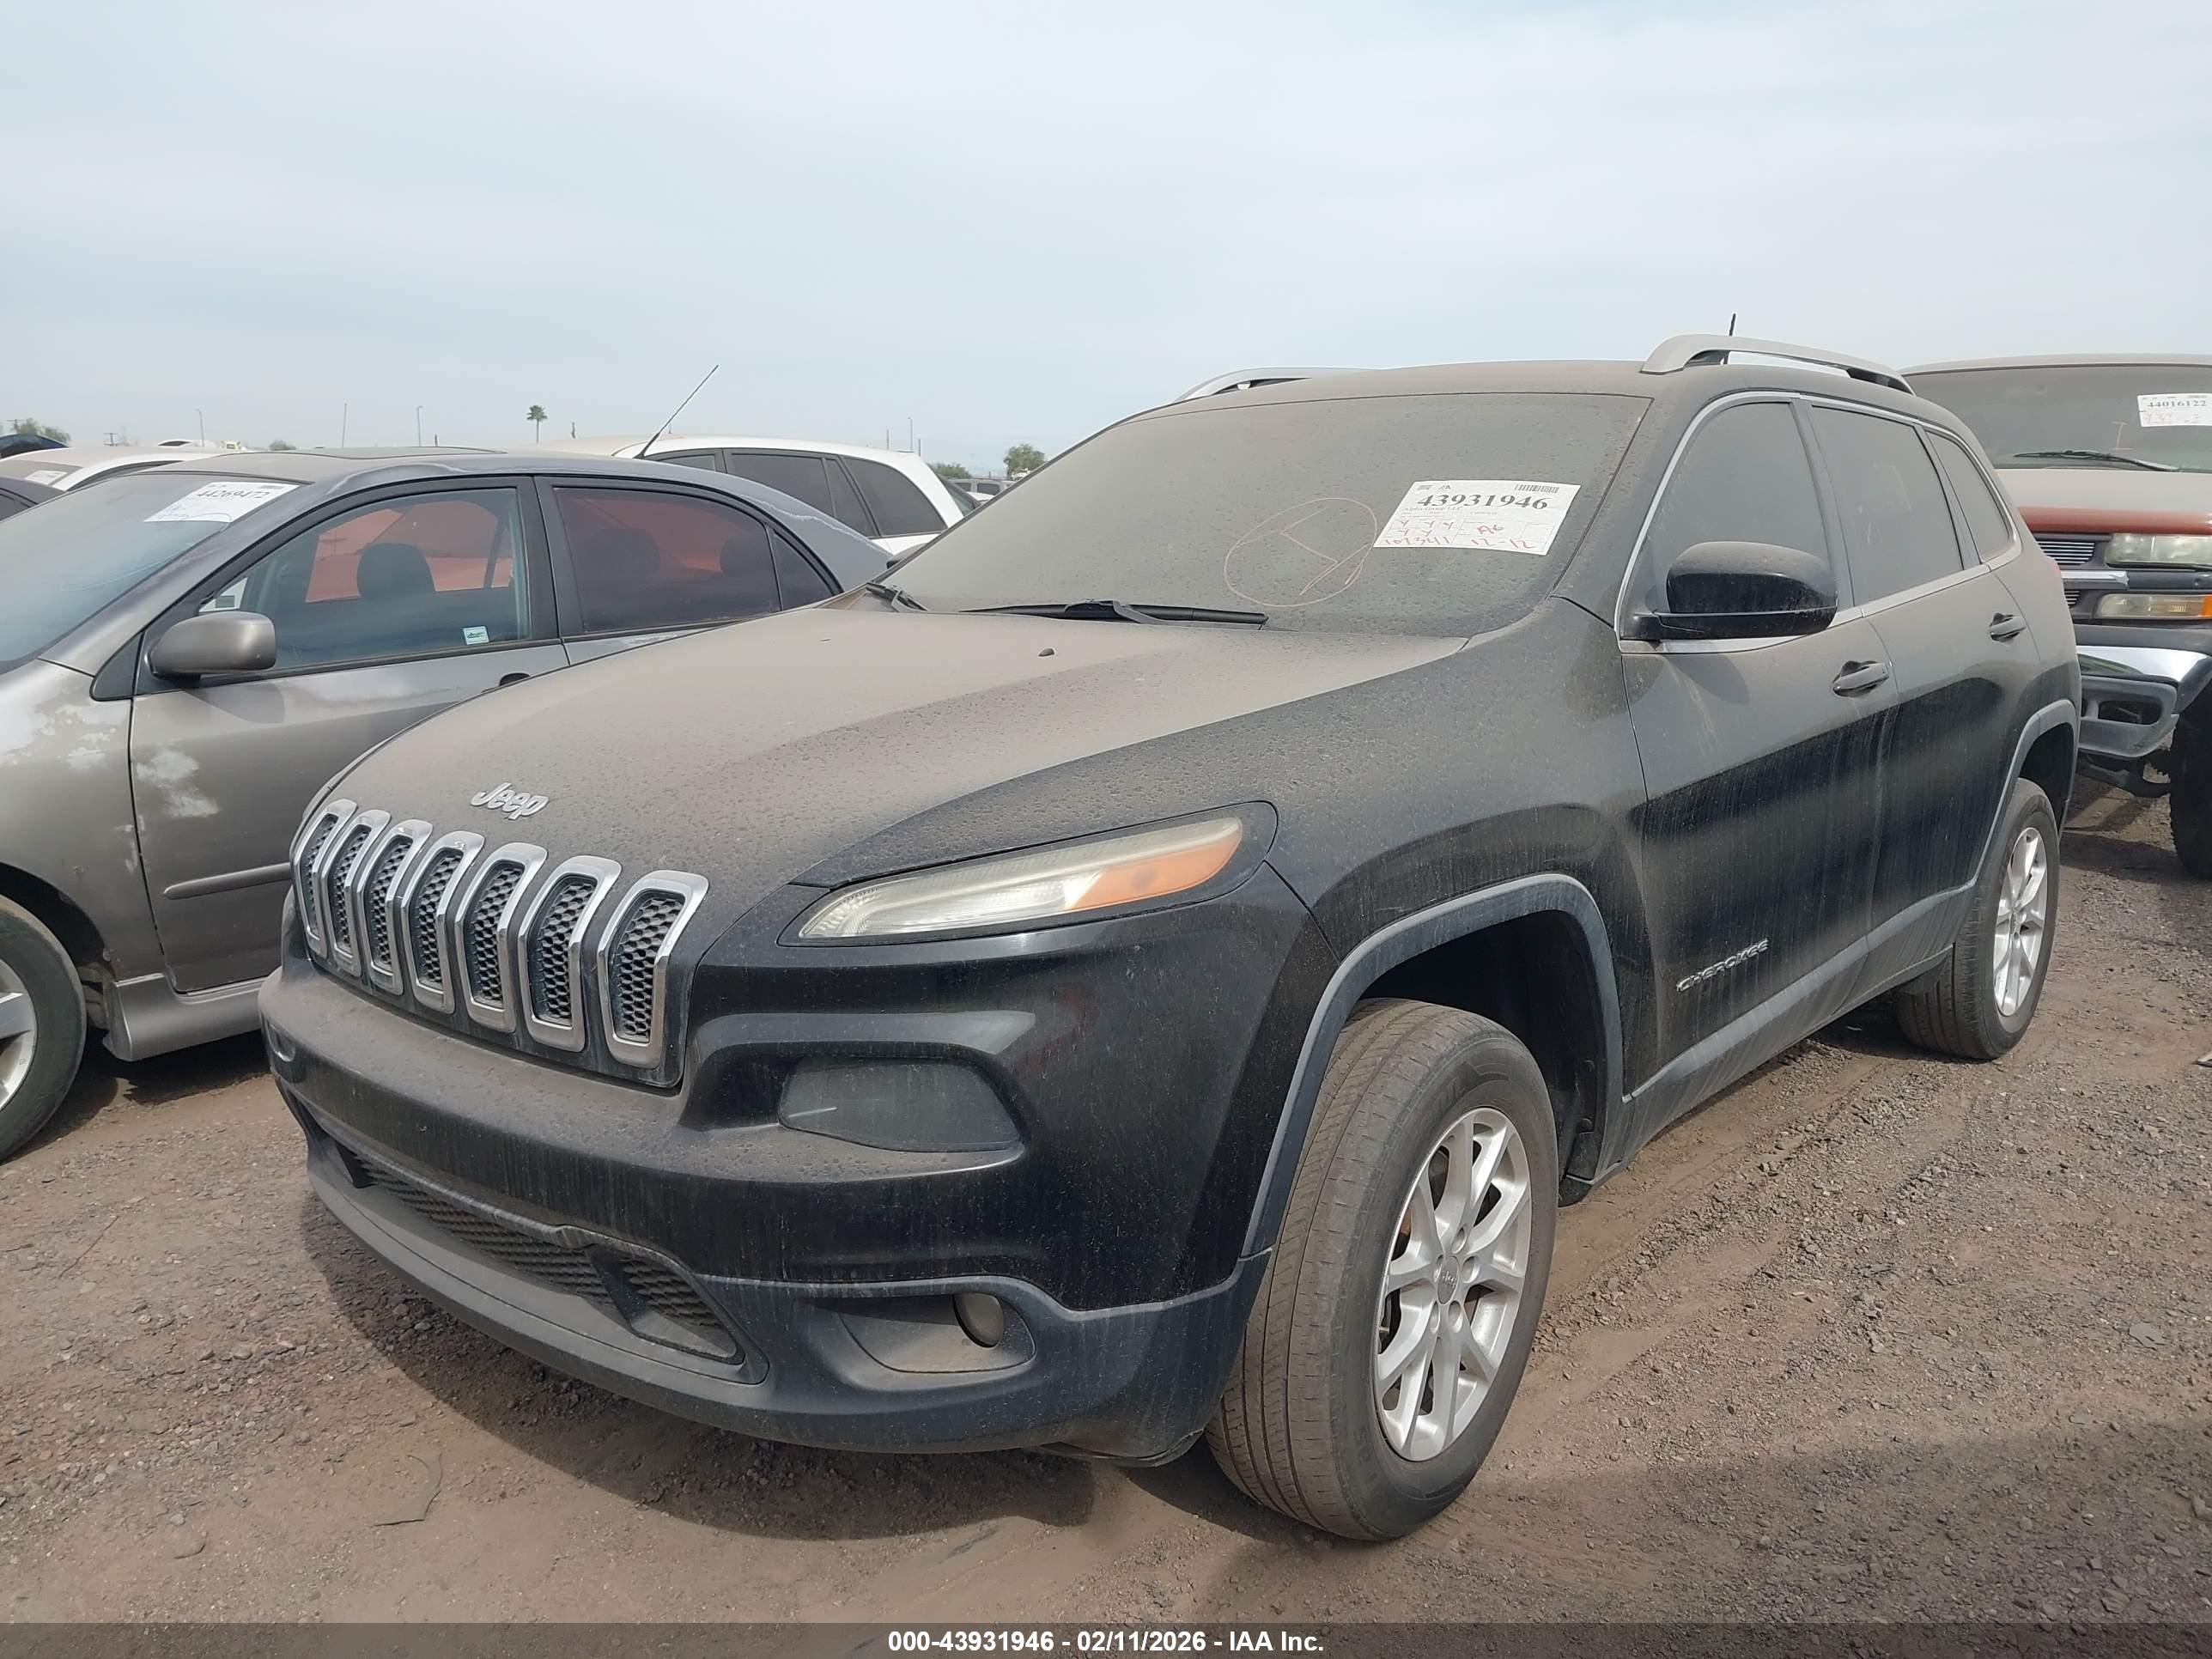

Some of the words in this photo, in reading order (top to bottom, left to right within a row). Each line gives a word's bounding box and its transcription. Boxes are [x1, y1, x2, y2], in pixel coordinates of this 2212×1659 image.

[1417, 494, 1553, 510] 43931946
[471, 781, 550, 821] Jeep
[1676, 939, 1769, 993] CHEROKEE
